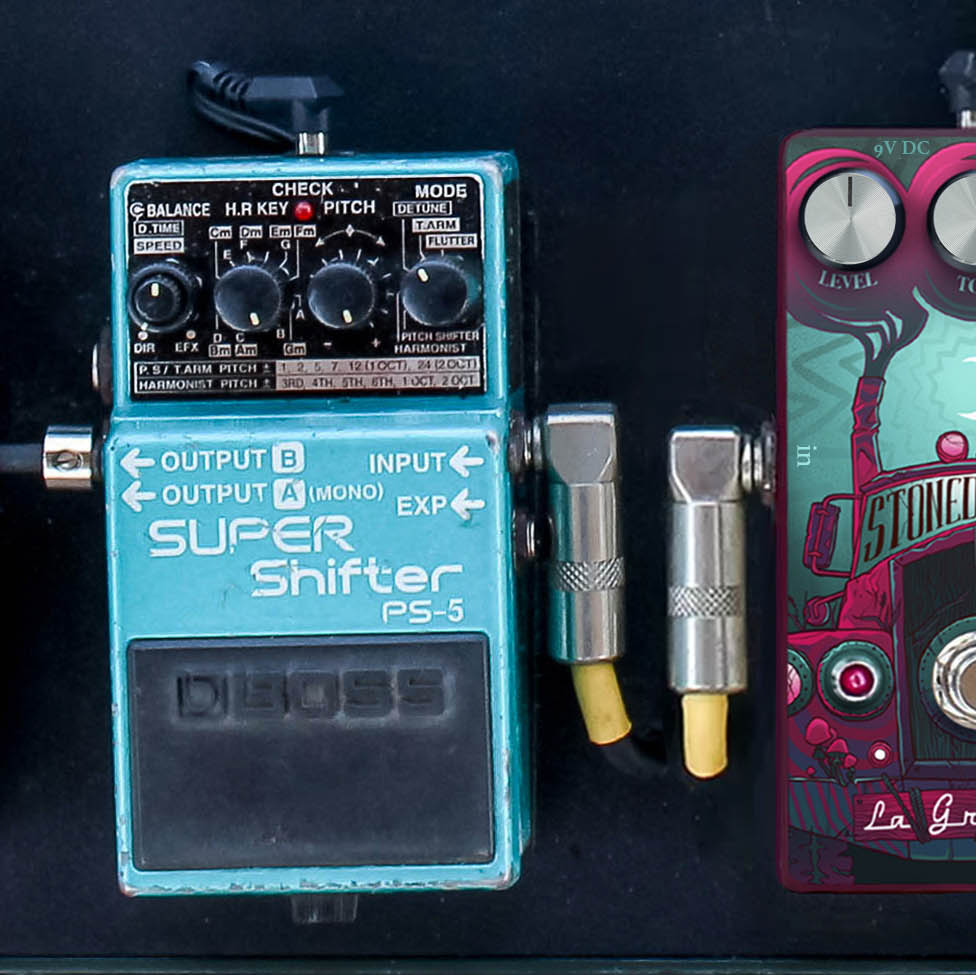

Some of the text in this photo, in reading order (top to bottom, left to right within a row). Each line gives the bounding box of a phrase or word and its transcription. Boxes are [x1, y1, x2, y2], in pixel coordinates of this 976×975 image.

[873, 140, 930, 159] 9V DC
[272, 182, 334, 196] CHECK
[415, 184, 468, 198] MODE
[147, 203, 210, 217] BALANCE
[225, 201, 289, 216] H.R KEY
[324, 200, 376, 214] PITCH
[397, 203, 447, 214] DETUNE
[210, 227, 231, 238] Cm
[241, 226, 261, 237] Dm
[271, 226, 290, 237] Em
[136, 239, 182, 252] SPEED
[240, 240, 248, 250] F
[280, 239, 291, 250] G
[428, 235, 475, 246] FLUTTER
[223, 250, 232, 260] E
[818, 270, 878, 290] LEVEL
[295, 309, 305, 320] A
[214, 333, 223, 343] D
[235, 332, 245, 343] C
[401, 330, 480, 342] PITCH SHIFTER
[134, 343, 156, 354] DIR
[175, 342, 199, 353] EFX
[236, 345, 257, 356] Am
[394, 343, 467, 354] HARMONIST
[219, 364, 257, 373] PITCH
[139, 379, 257, 391] HARMONIST PITCH
[161, 449, 298, 471] OUTPUT B
[796, 444, 818, 467] in
[369, 452, 447, 474] INPUT
[162, 482, 384, 505] OUTPUT A (MONO)
[397, 496, 447, 516] EXP
[148, 514, 355, 557] SUPER
[250, 558, 463, 597] Shifter
[382, 598, 464, 624] PS-5
[863, 800, 910, 830] La
